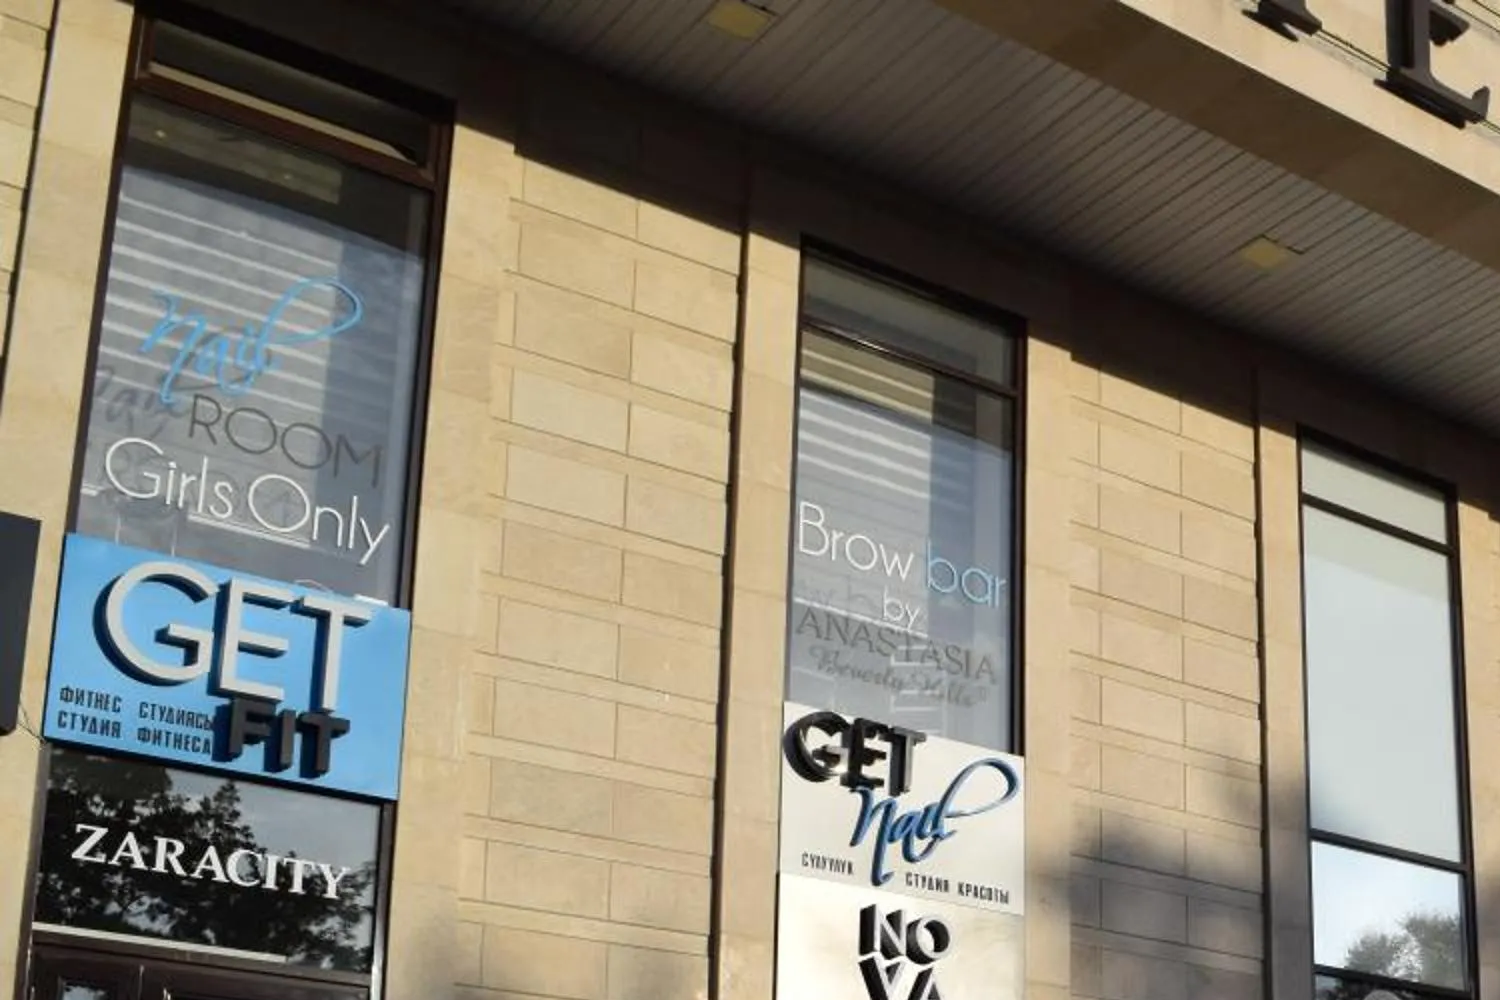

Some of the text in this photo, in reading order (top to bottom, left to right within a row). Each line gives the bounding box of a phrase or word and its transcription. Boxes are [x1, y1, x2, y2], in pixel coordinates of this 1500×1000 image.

[188, 394, 382, 488] ROOM
[105, 437, 390, 565] Girls Only
[799, 500, 1007, 607] Brow bar
[93, 560, 372, 713] GET
[882, 585, 921, 628] by
[796, 607, 999, 686] ANASTASIA
[57, 710, 212, 755] СТУДИЯ ФИТНЕСА
[59, 686, 122, 713] ФИТНЕС
[212, 698, 352, 778] FIT
[783, 711, 927, 797] GET
[71, 823, 350, 900] ZARACITY
[905, 871, 1010, 905] СТУДИЯ КРАСОТЫ
